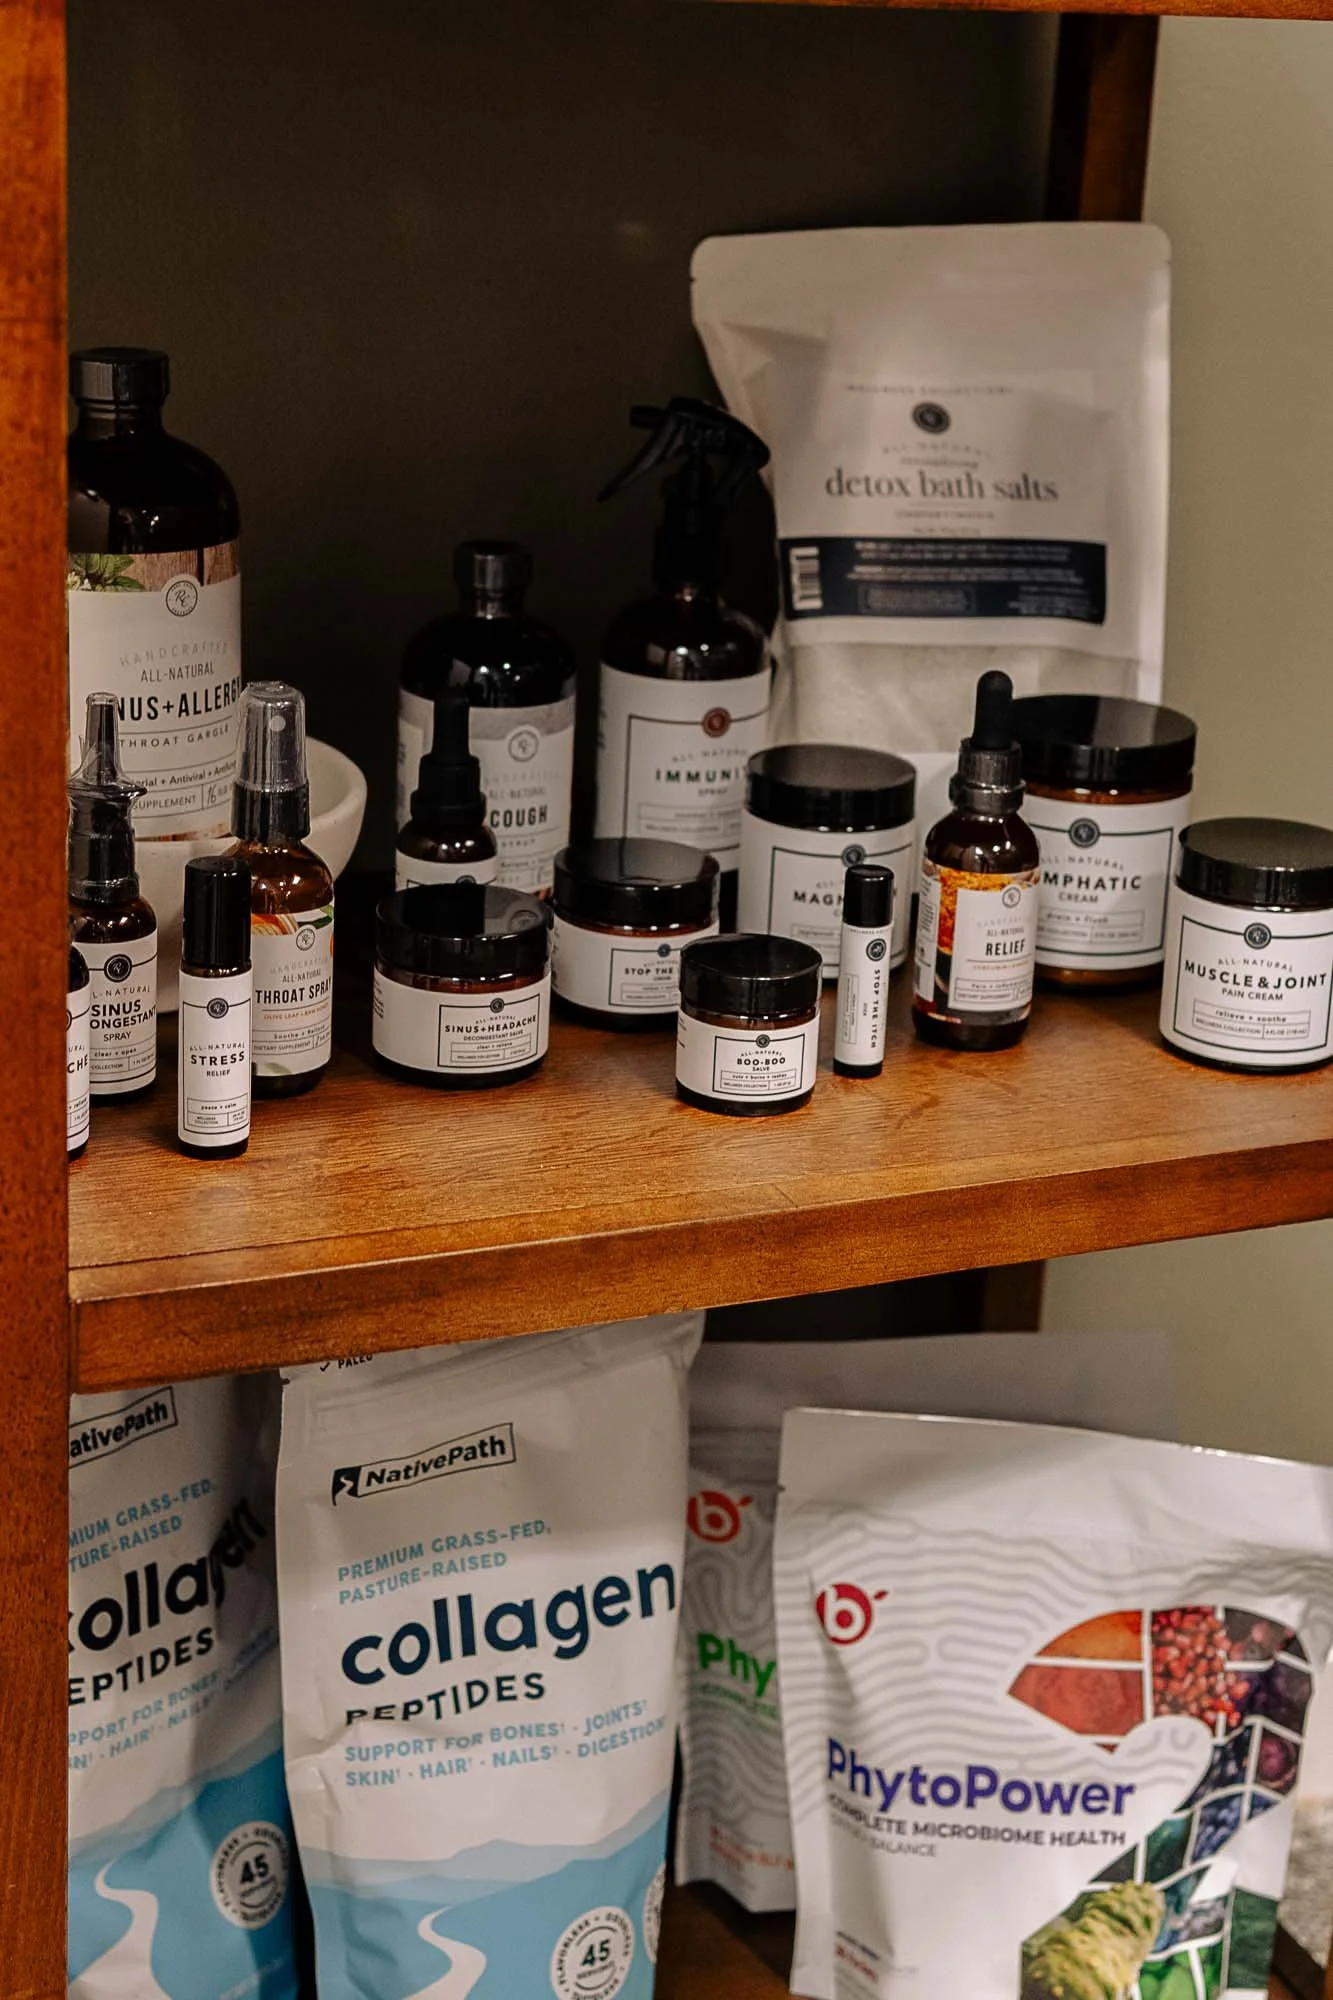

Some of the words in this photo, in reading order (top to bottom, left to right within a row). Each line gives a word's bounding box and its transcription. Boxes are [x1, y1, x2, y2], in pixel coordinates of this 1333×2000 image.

[825, 465, 911, 498] detox
[918, 469, 985, 499] bath
[991, 472, 1060, 502] salts
[140, 661, 215, 683] ALL-NATURAL
[120, 736, 179, 748] THROAT
[187, 723, 229, 744] GARGLE
[489, 804, 548, 829] COUGH
[1058, 891, 1100, 904] CREAM
[985, 937, 1026, 957] RELIEF
[624, 967, 651, 976] STOP
[655, 967, 673, 975] THE
[873, 969, 881, 995] STOP
[255, 987, 306, 1005] THROAT
[1221, 987, 1245, 998] PAIN
[1247, 991, 1284, 1001] CREAM
[91, 999, 142, 1018] SINUS
[872, 1000, 880, 1021] THE
[1215, 1008, 1245, 1020] relieve
[1257, 1014, 1287, 1023] soothe
[103, 1031, 133, 1042] SPRAY
[189, 1042, 245, 1052] ALL-NATURAL
[870, 1023, 879, 1049] ITCH
[190, 1051, 245, 1066] STRESS
[736, 1057, 786, 1066] BOO-BOO
[206, 1068, 231, 1078] RELIEF
[337, 1353, 373, 1369] PALEO
[364, 1434, 506, 1488] NativePath
[337, 1542, 425, 1583] PREMIUM
[337, 1551, 508, 1606] PASTURE-RAISED
[341, 1562, 676, 1686] collagen
[68, 1627, 215, 1706] EPTIDES
[132, 1698, 164, 1724] FOR
[345, 1672, 546, 1727] PEPTIDES
[344, 1736, 437, 1763] SUPPORT
[443, 1732, 484, 1751] FOR
[827, 1737, 1137, 1816] PhytoPower
[912, 1821, 1045, 1846] MICROBIOME
[1049, 1829, 1127, 1846] HEALTH
[239, 1852, 270, 1885] 45
[581, 1938, 611, 1967] 45
